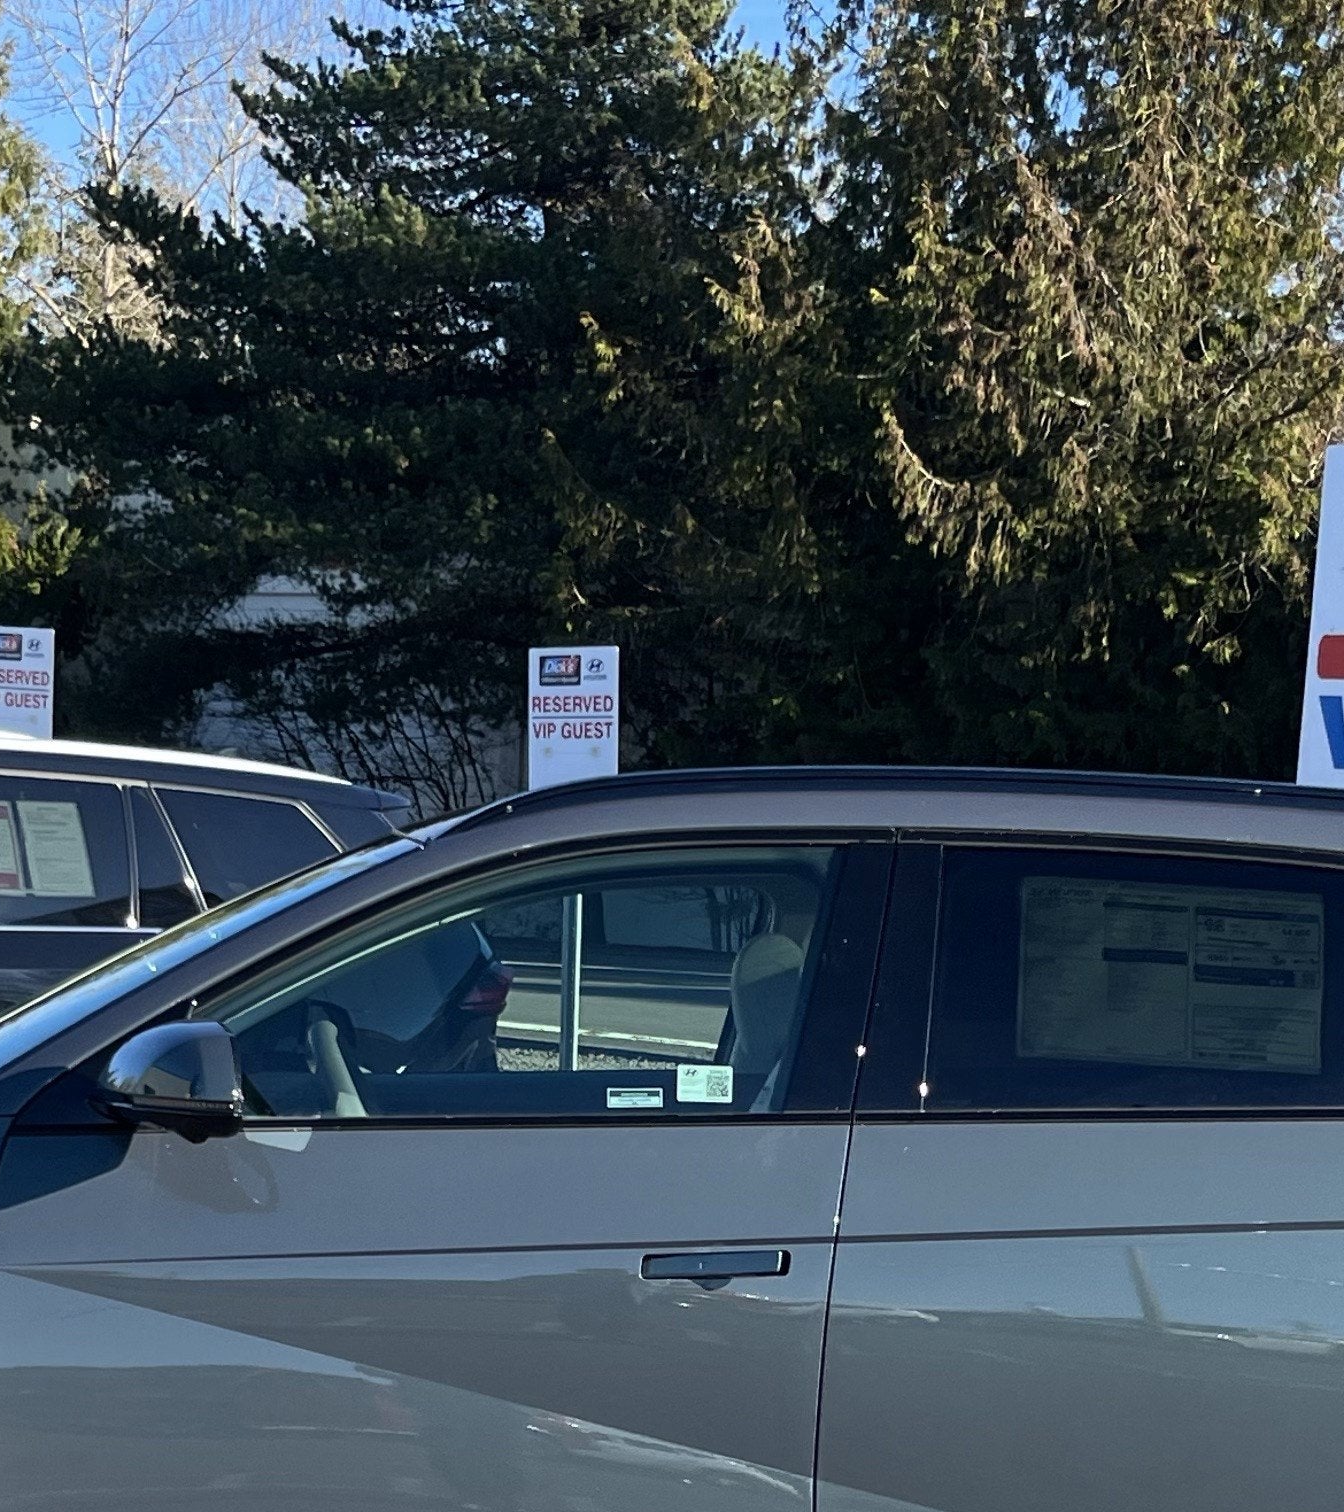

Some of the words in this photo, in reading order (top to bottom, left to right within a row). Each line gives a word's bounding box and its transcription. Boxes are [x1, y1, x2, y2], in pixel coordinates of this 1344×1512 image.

[4, 691, 49, 709] GUEST
[532, 695, 614, 713] RESERVED
[532, 721, 557, 740] VIP
[561, 721, 613, 740] GUEST
